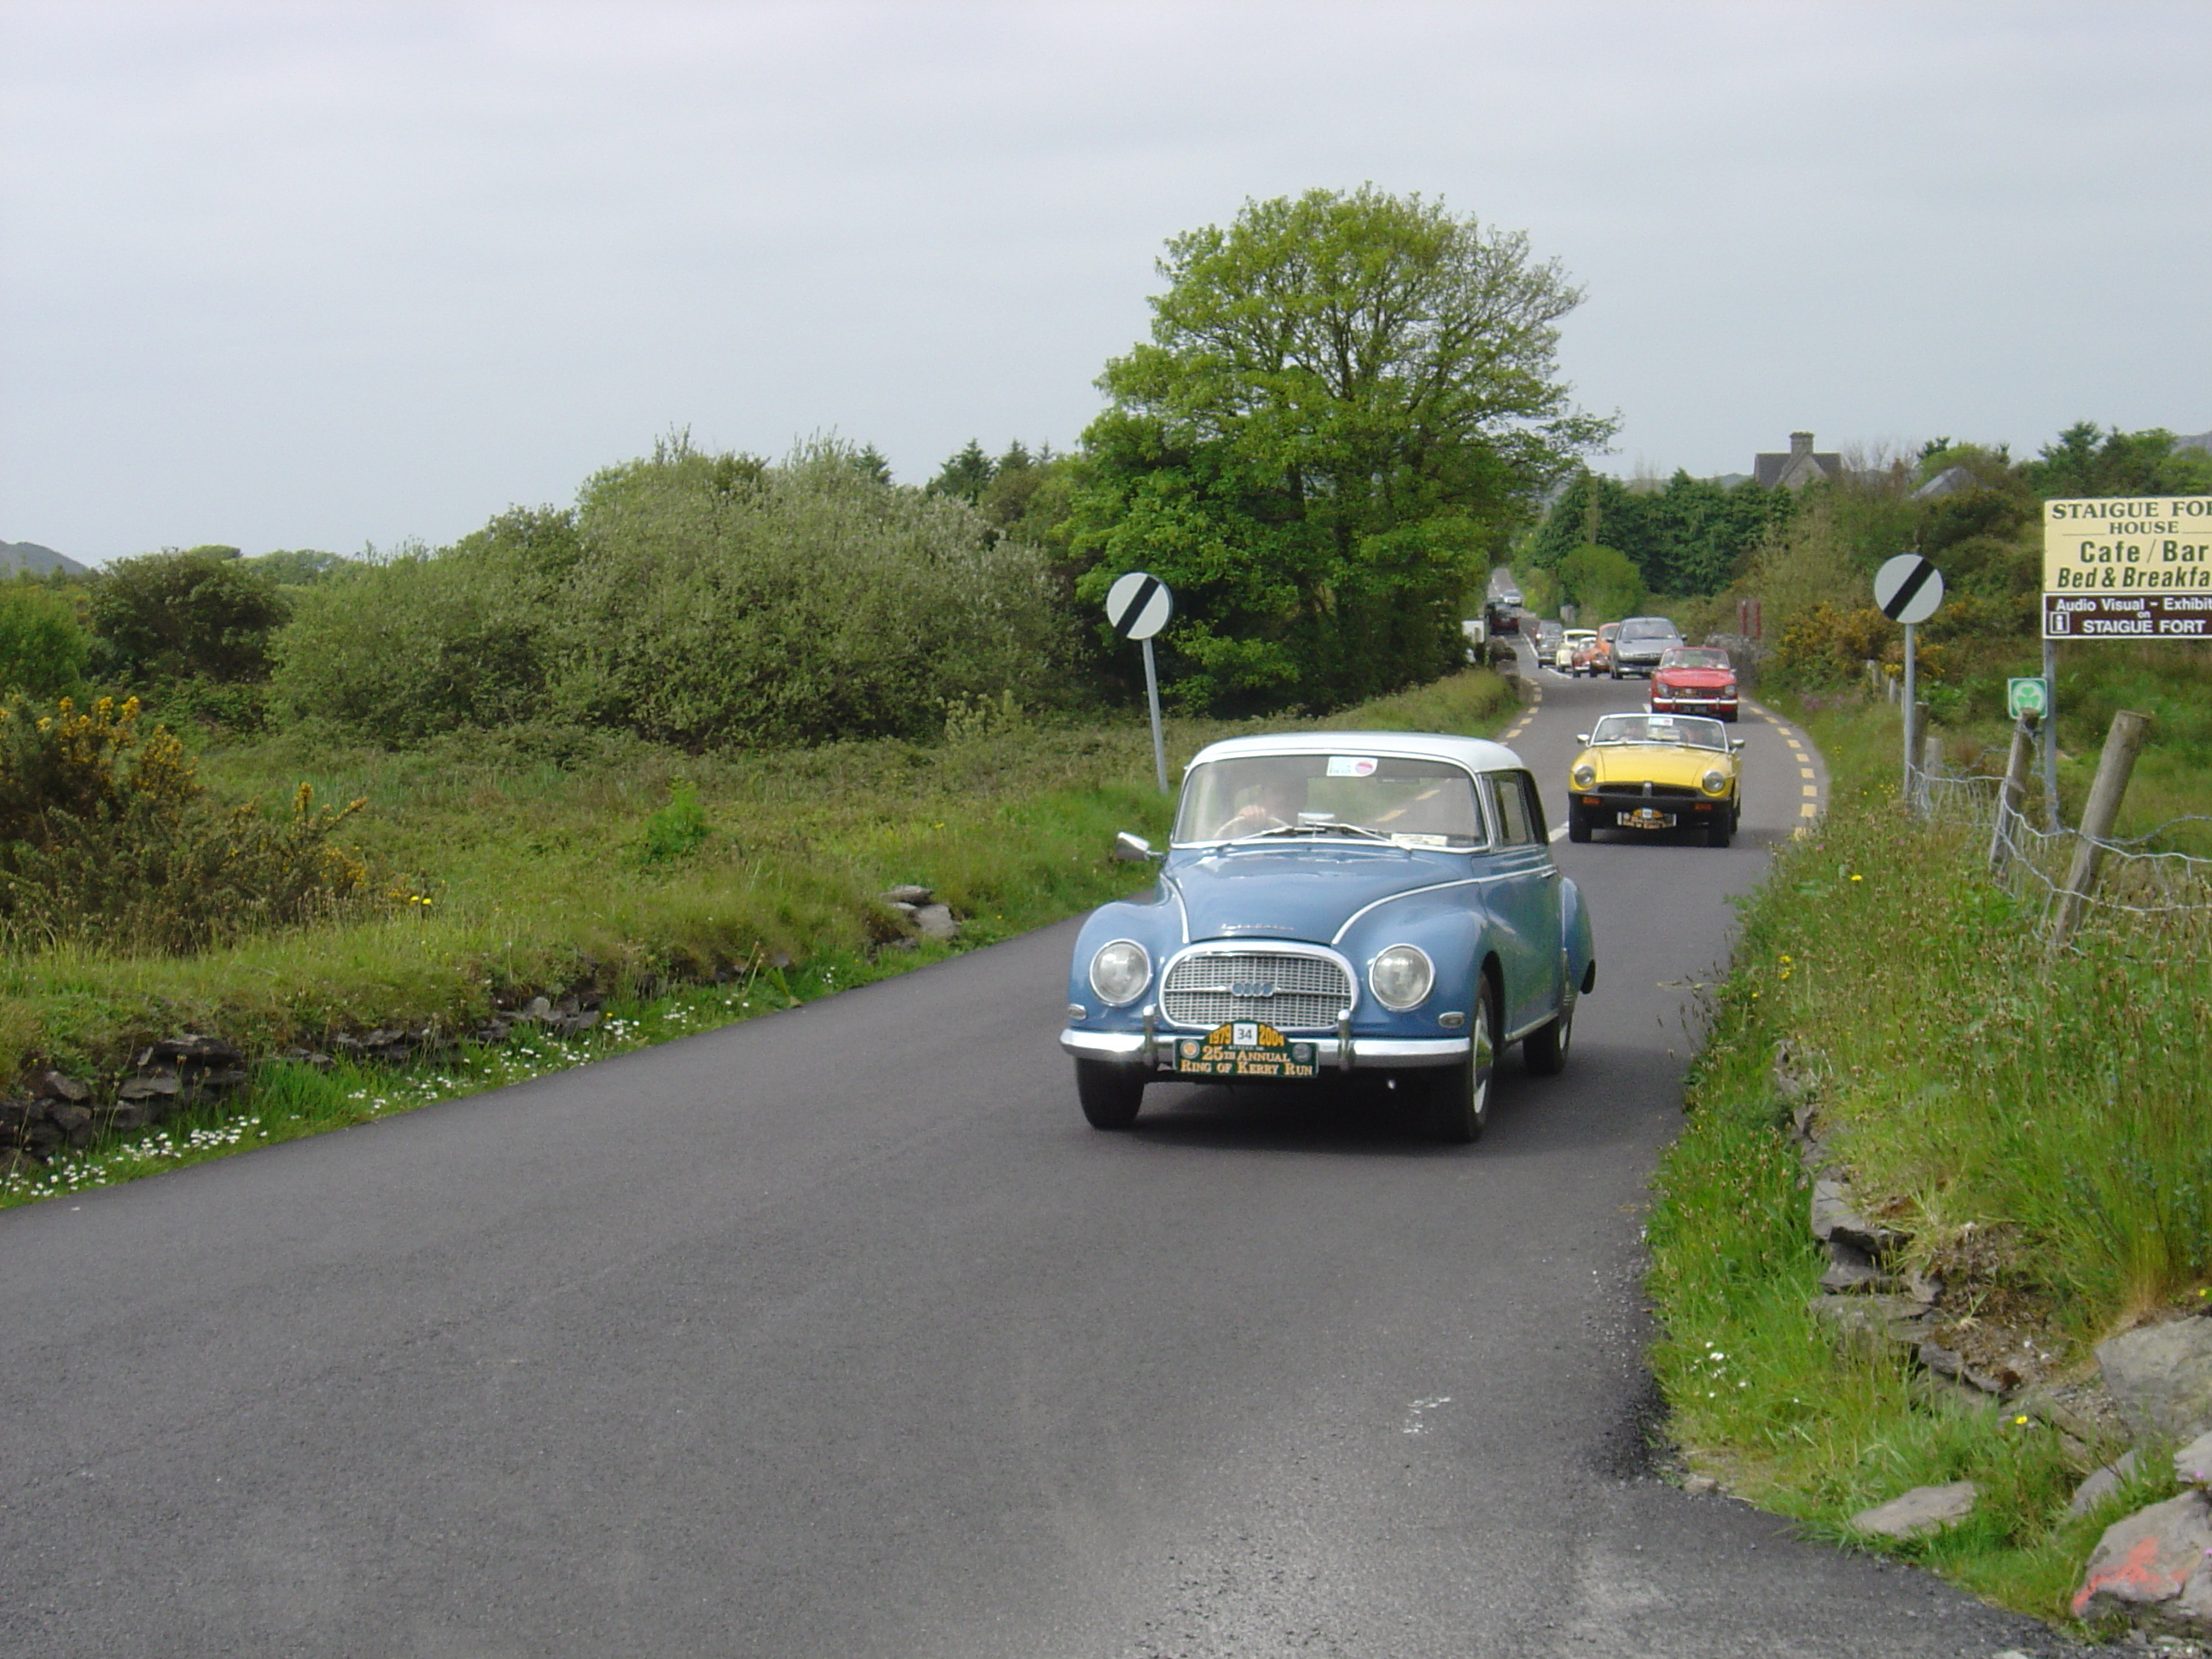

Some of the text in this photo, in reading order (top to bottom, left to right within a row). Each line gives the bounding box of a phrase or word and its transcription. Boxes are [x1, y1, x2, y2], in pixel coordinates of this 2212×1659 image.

[2052, 502, 2159, 520] STAIGUE
[2109, 521, 2179, 535] HOUSE
[2081, 540, 2140, 563] Cafe
[2163, 539, 2209, 562] Bar
[2058, 566, 2210, 588] Bed & Breakfa
[2056, 598, 2097, 612] Audio
[2101, 597, 2145, 611] Visual
[2082, 620, 2206, 633] STAIGUE FORT
[1208, 1023, 1285, 1047] 1979 34 2004
[1237, 1050, 1291, 1062] ANNUAL
[1180, 1059, 1313, 1076] RING OF KERRY RUN
